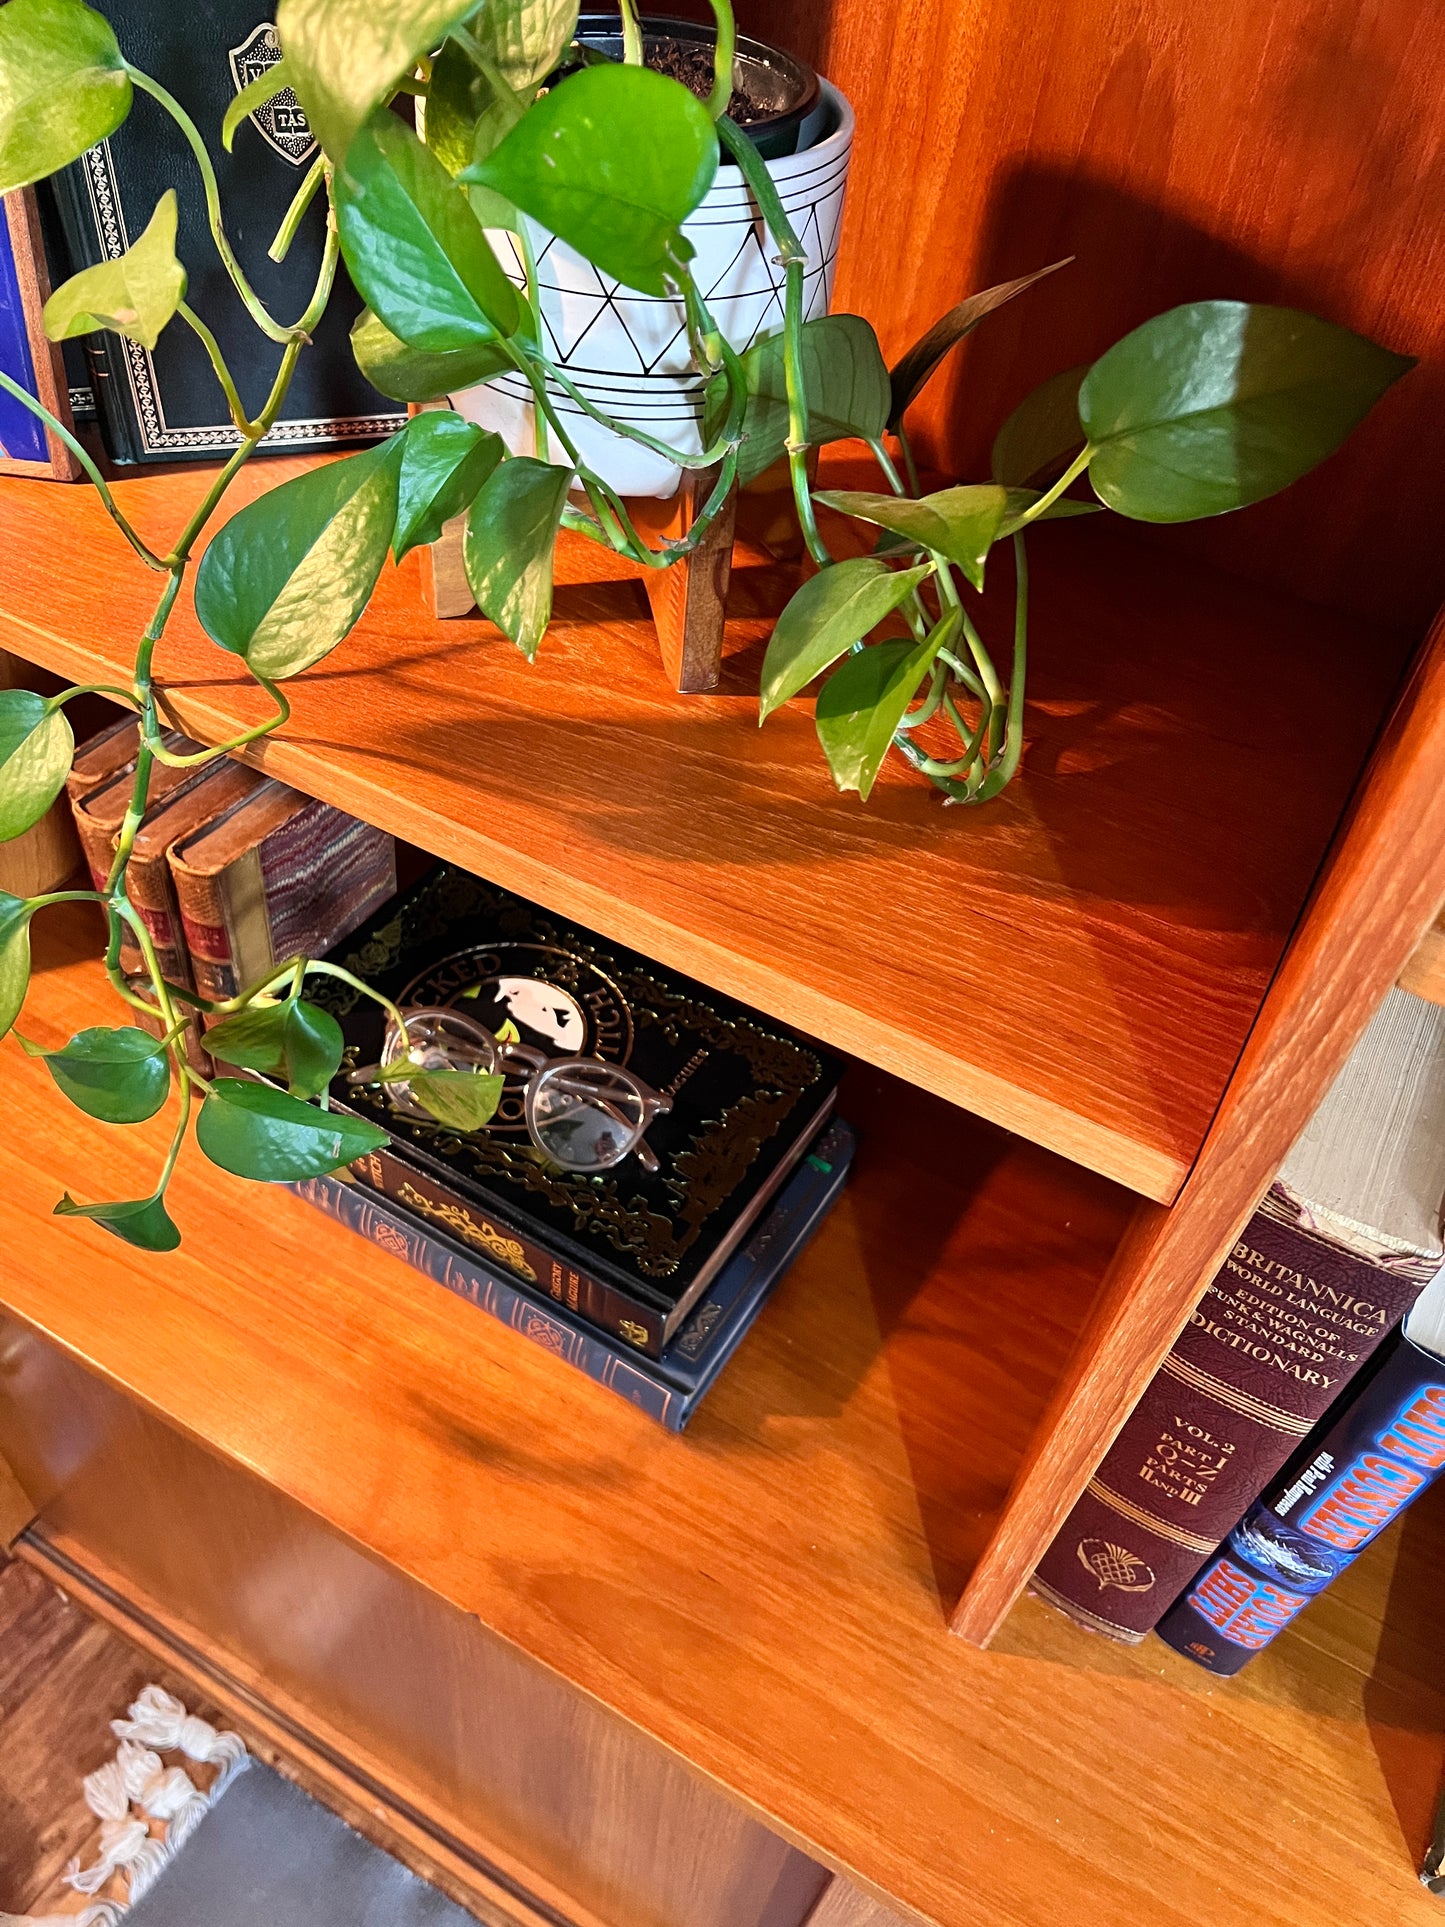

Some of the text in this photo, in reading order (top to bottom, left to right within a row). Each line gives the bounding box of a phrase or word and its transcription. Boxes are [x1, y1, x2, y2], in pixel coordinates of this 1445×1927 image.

[278, 113, 306, 127] TAS
[1227, 1259, 1380, 1338] WORLD LANGUAGE
[1232, 1242, 1387, 1324] BRITANNICA
[1208, 1285, 1359, 1363] FUNK & WAGNALLS
[1224, 1310, 1325, 1363] STANDARD
[1235, 1288, 1341, 1342] EDITION OF
[1190, 1312, 1339, 1389] DICTIONARY
[1160, 1433, 1229, 1470] PART I
[1174, 1416, 1236, 1455] VOL. 2
[1139, 1465, 1202, 1506] II AND III
[1146, 1457, 1208, 1493] PARTS
[1301, 1465, 1327, 1490] Paul
[1313, 1451, 1335, 1474] with
[1301, 1455, 1426, 1549] CUSSLER
[1188, 1560, 1257, 1628] SHIFT
[1222, 1584, 1306, 1649] POLAR
